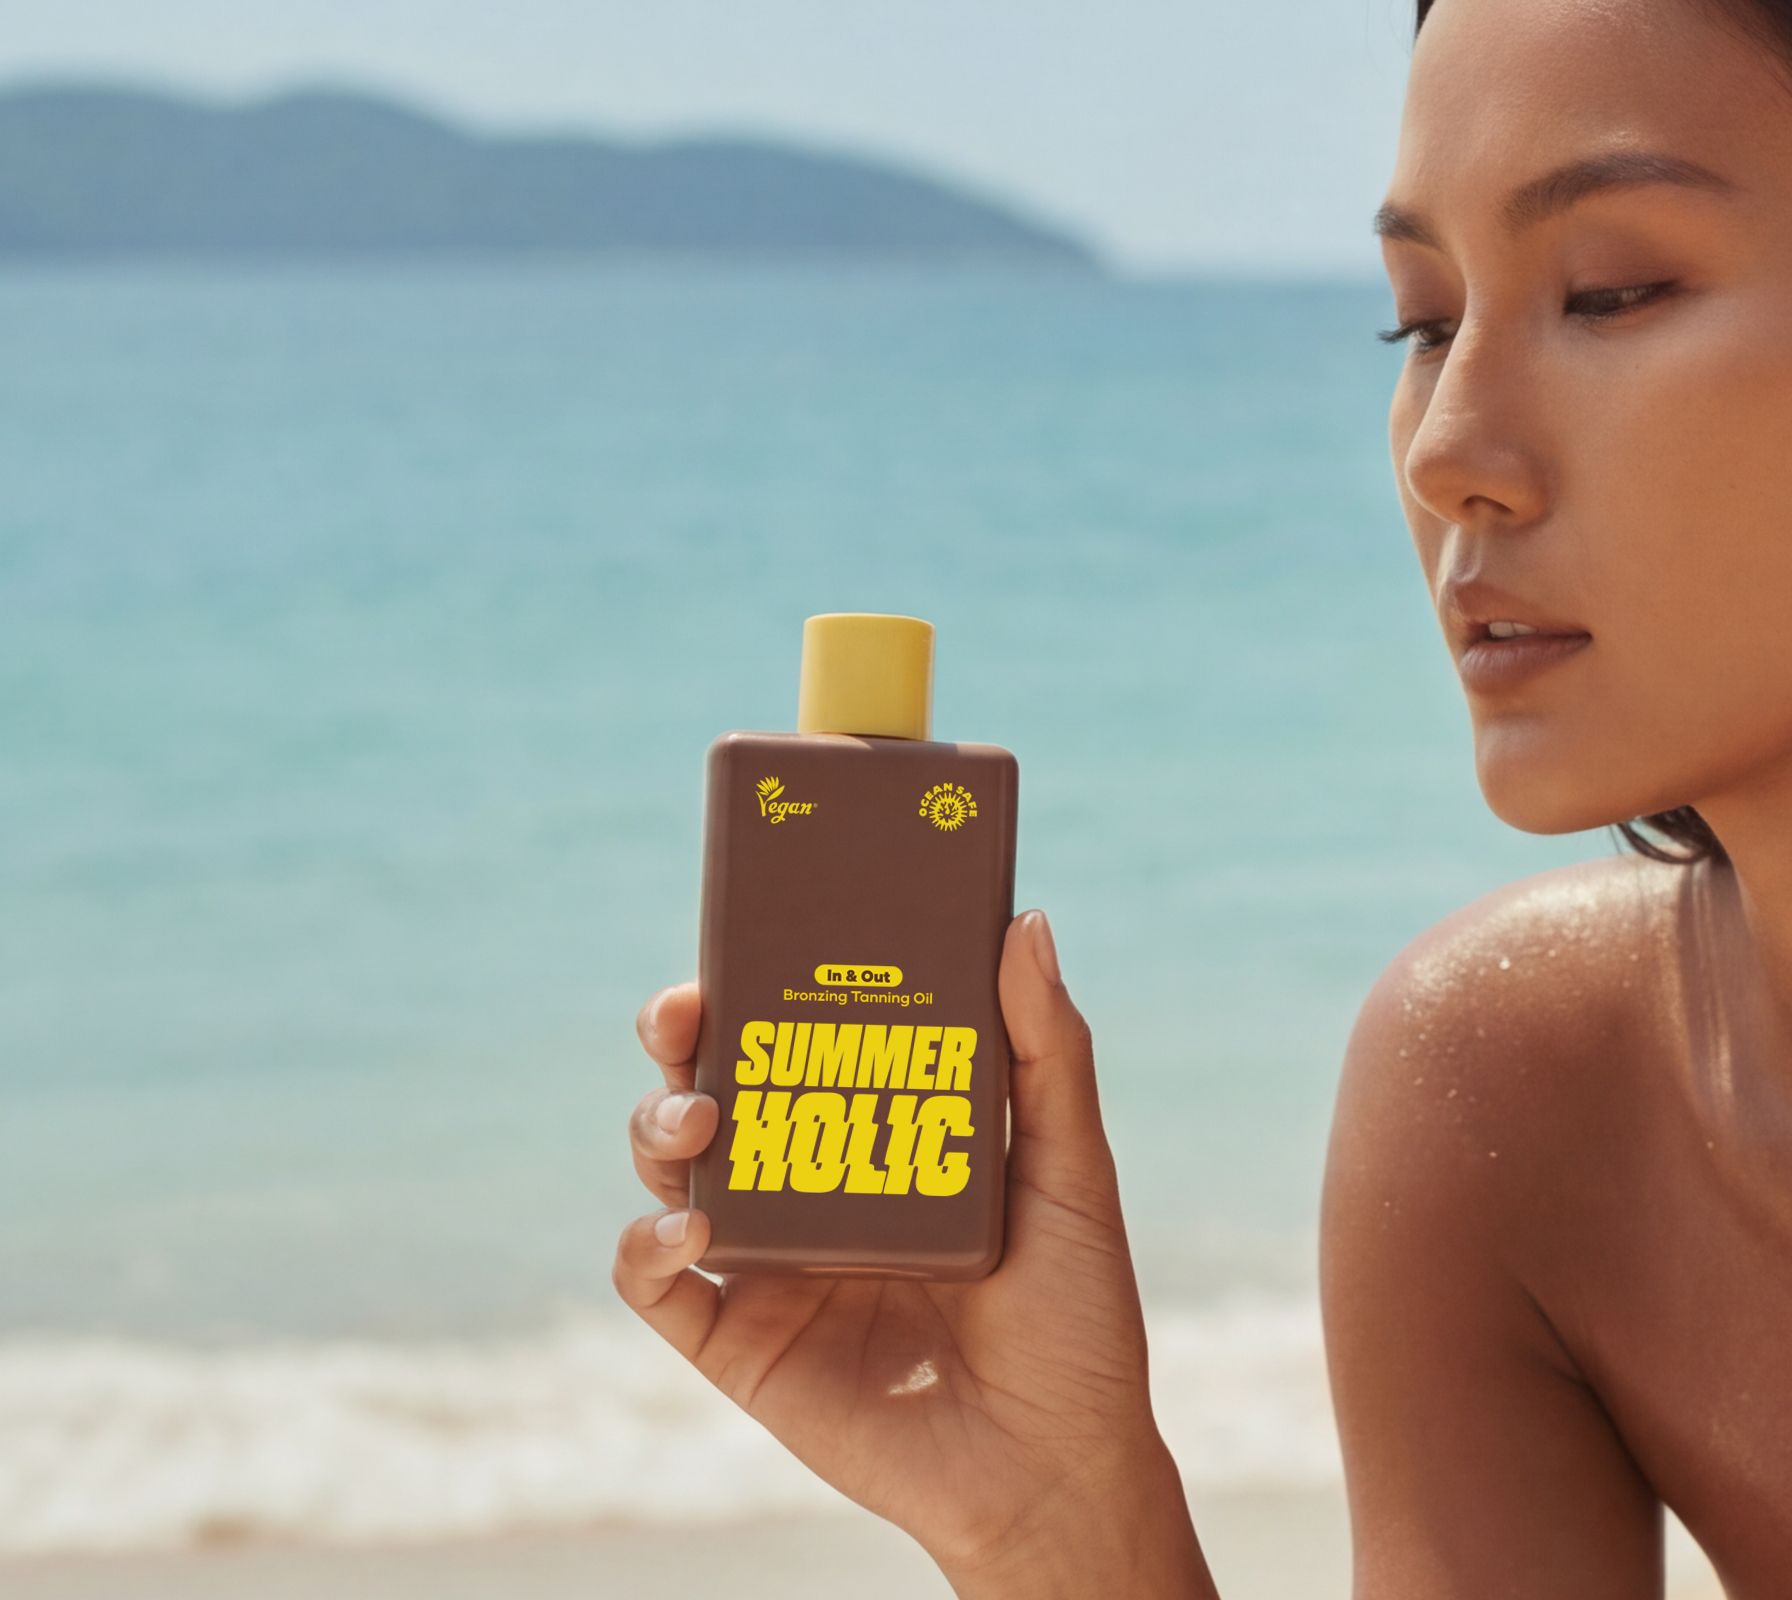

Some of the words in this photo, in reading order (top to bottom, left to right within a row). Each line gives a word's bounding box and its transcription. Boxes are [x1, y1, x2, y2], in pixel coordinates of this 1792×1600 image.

[918, 782, 953, 817] OCEAN
[956, 785, 978, 817] SAFE
[827, 969, 842, 982] In
[845, 969, 858, 983] &
[861, 970, 891, 984] Out
[783, 988, 848, 1006] Bronzing
[850, 990, 910, 1008] Tanning
[913, 992, 933, 1005] Oil
[734, 1020, 978, 1092] SUMMER
[727, 1090, 976, 1197] HOLIC
